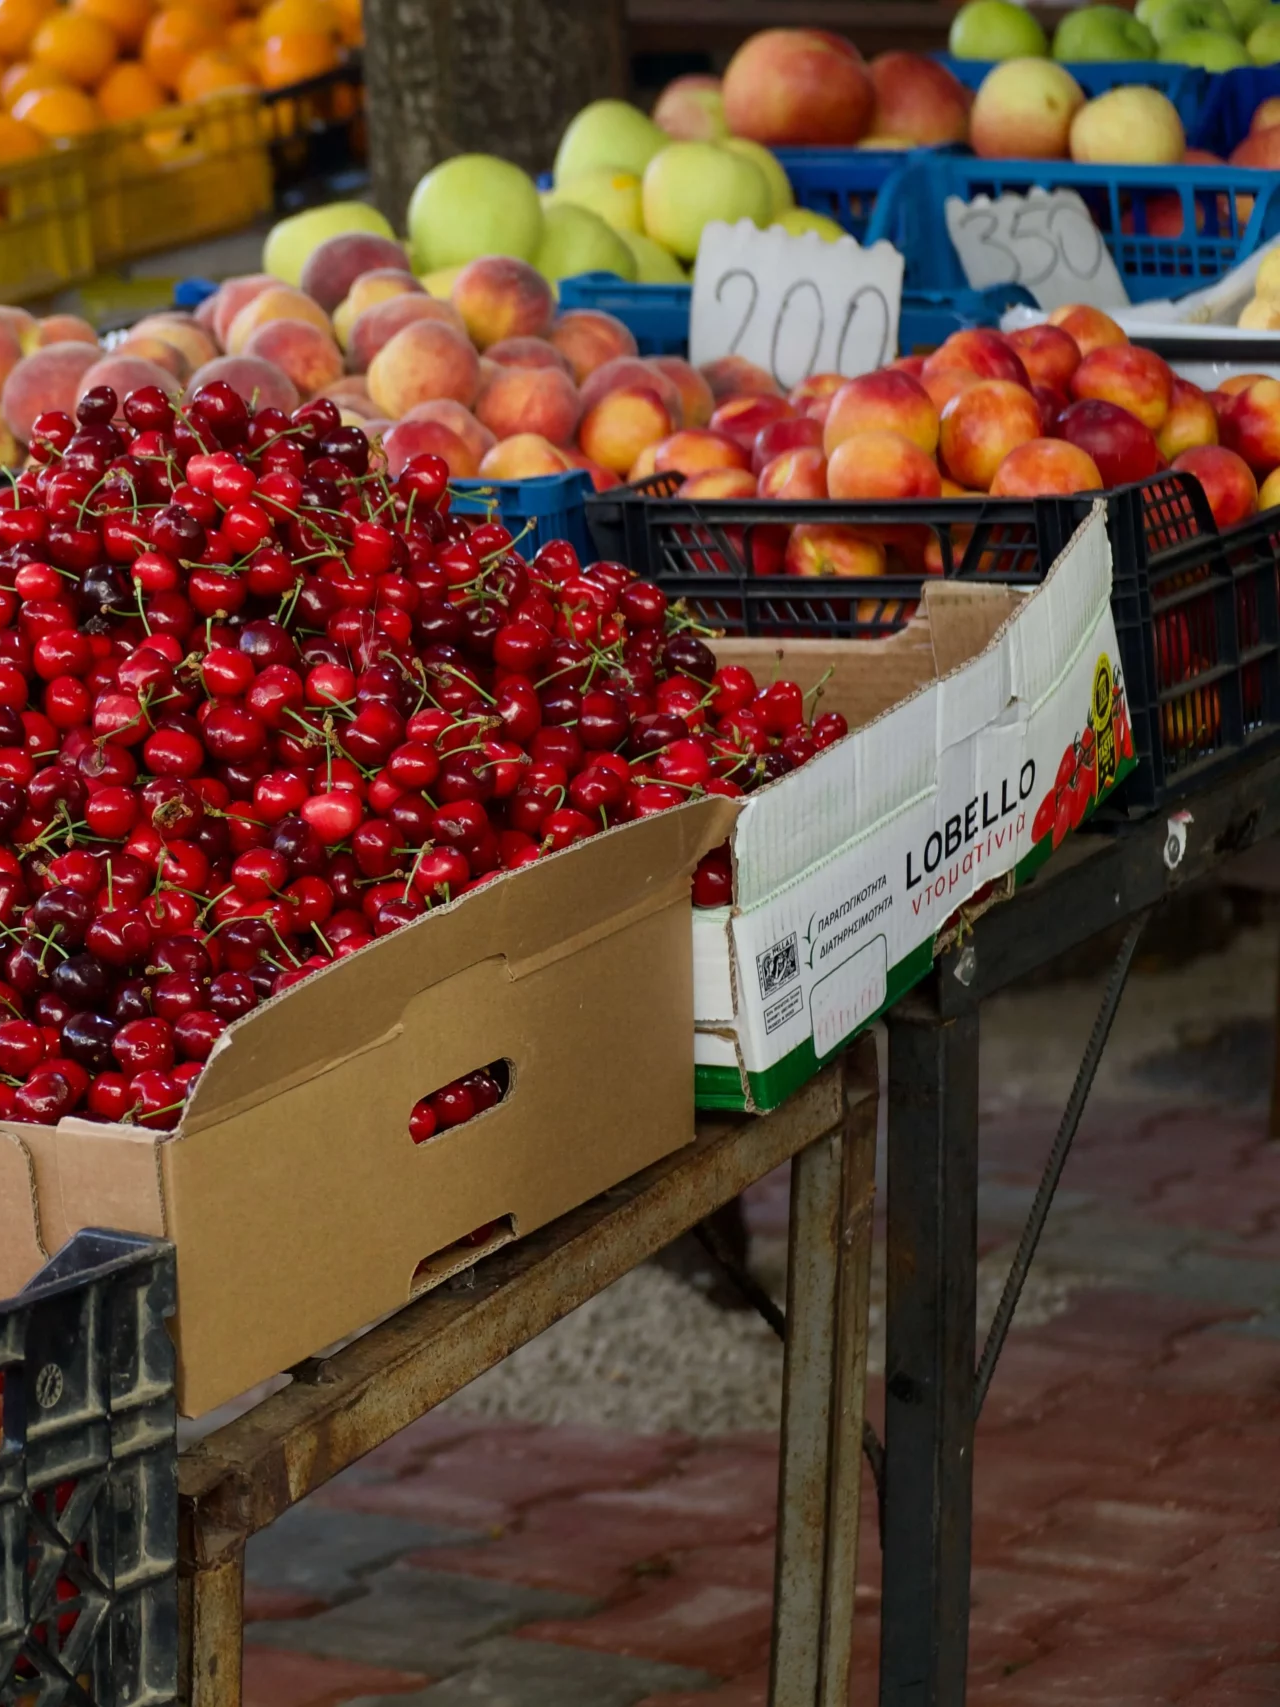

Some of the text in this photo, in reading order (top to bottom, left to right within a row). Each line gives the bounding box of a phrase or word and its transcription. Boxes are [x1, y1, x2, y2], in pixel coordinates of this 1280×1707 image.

[958, 201, 1103, 286] 350
[715, 268, 890, 394] 200
[905, 758, 1036, 892] LOBELLO
[911, 811, 1027, 917] ντοματίνια
[818, 873, 887, 934] ΠΑΡΑΓΩΓΙΚΟΤΗΤΑ
[819, 893, 893, 960] ΔΙΑΤΗΡΗΣΙΜΟΤΗΤΑ
